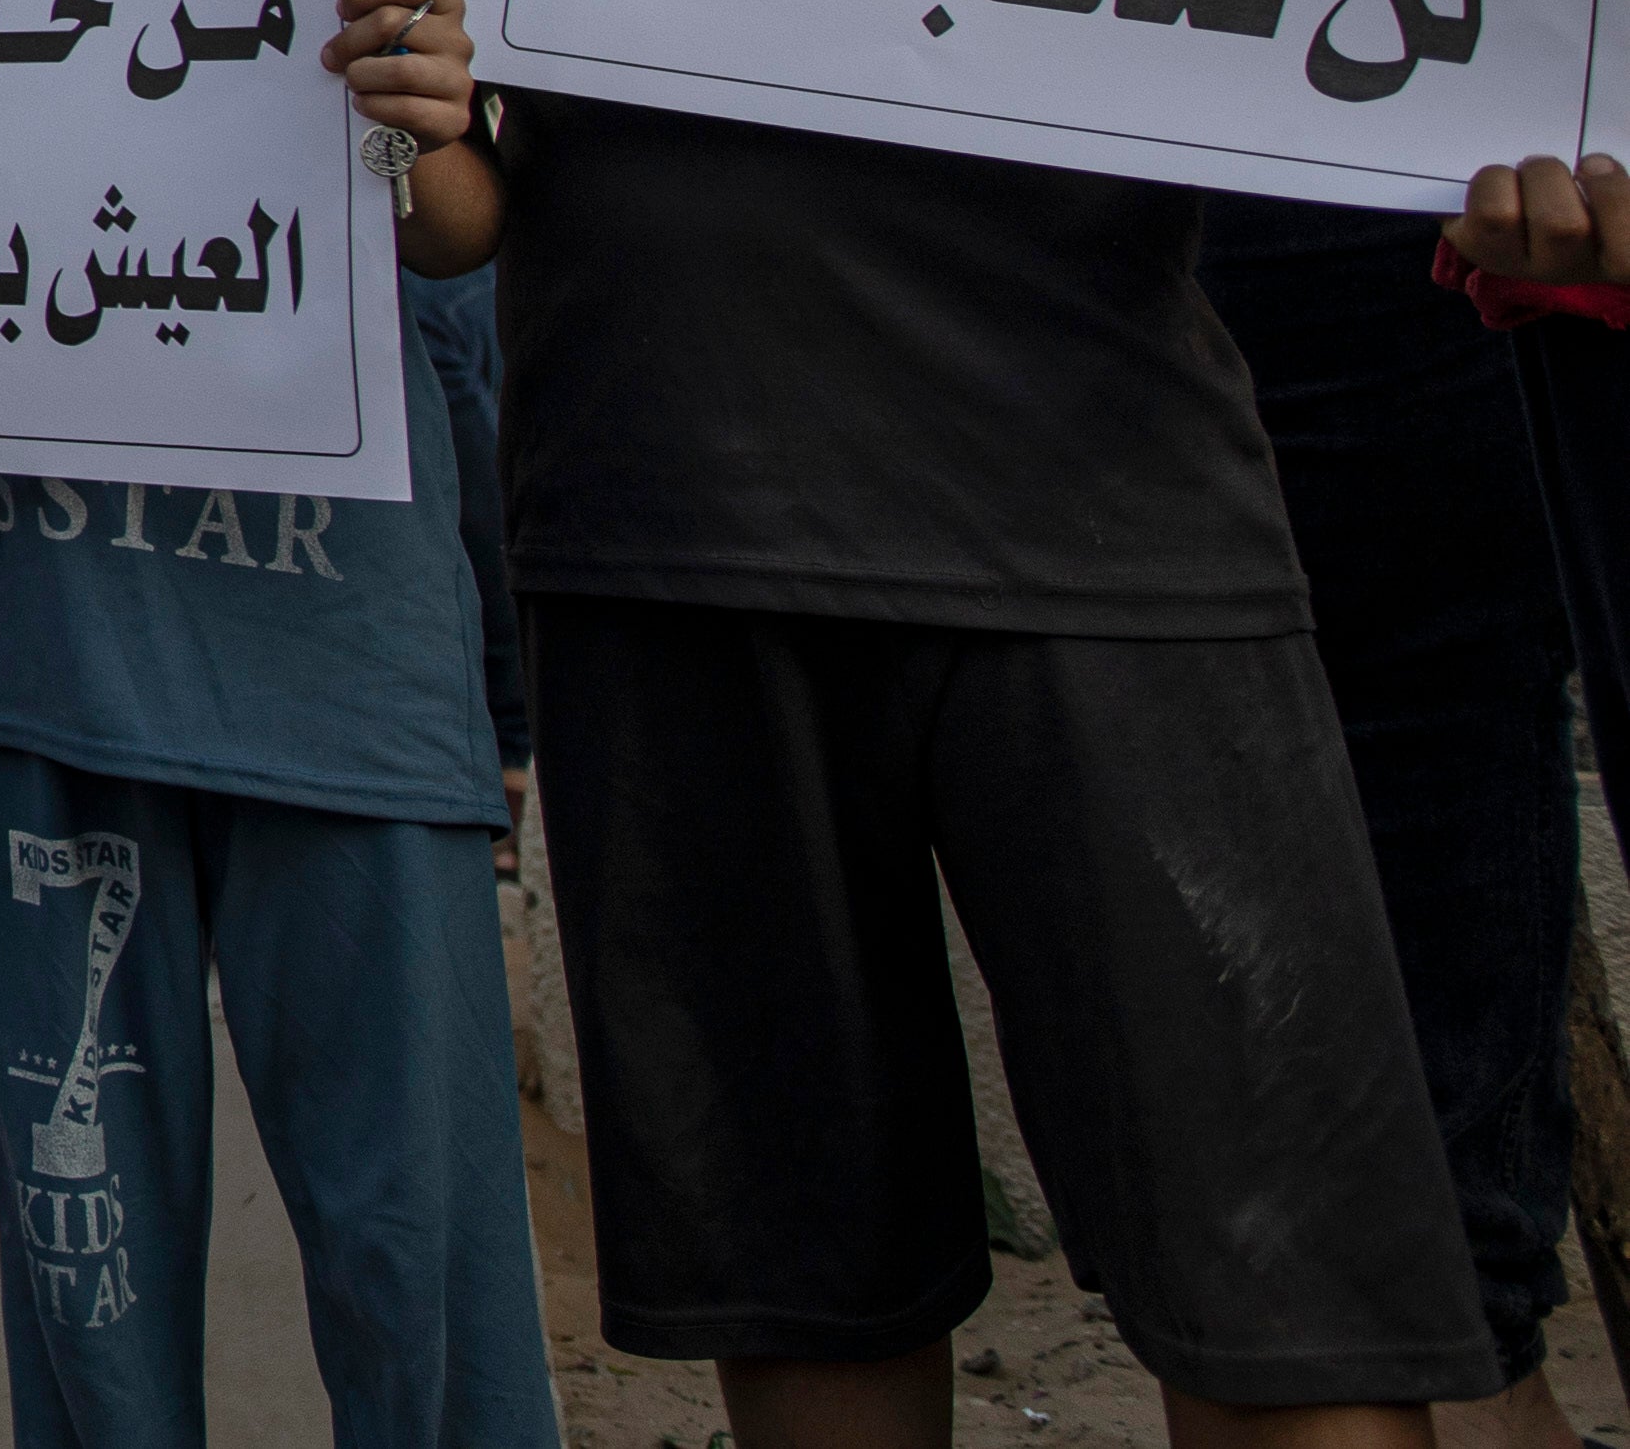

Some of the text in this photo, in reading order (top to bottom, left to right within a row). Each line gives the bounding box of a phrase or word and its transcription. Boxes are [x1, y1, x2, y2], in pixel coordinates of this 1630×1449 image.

[46, 184, 304, 347] العيش
[38, 478, 344, 582] STAR
[17, 841, 133, 875] KIDS STAR
[13, 1173, 124, 1255] KIDS
[27, 1246, 137, 1328] TAR
